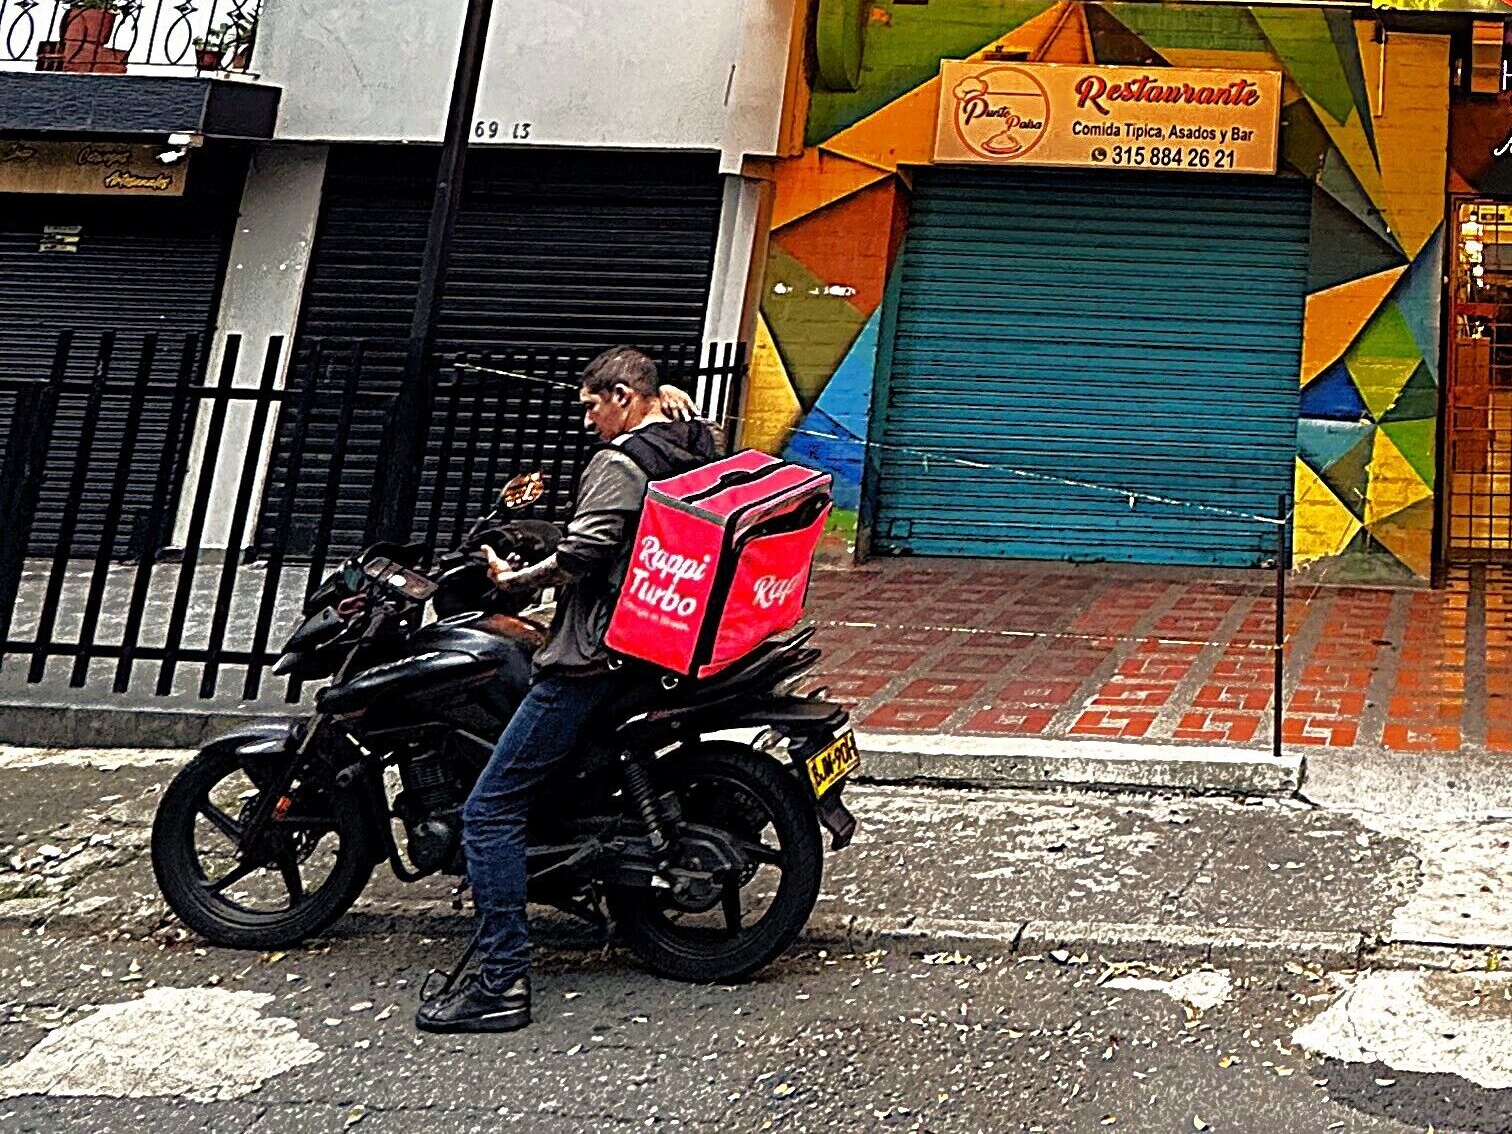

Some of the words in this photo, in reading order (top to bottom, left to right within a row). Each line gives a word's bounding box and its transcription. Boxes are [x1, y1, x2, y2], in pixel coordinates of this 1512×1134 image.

[1075, 75, 1261, 116] Restaurante
[963, 97, 1011, 126] Punto
[1005, 115, 1042, 131] Paisa
[474, 120, 499, 139] 69
[1072, 120, 1121, 137] Comida
[1168, 124, 1216, 141] Asados
[1219, 129, 1228, 144] y
[1231, 126, 1254, 142] Bar
[1111, 145, 1145, 166] 315
[1149, 147, 1183, 167] 884
[1187, 148, 1210, 168] 26
[1214, 149, 1235, 169] 21
[639, 535, 711, 584] Rappi
[630, 567, 698, 616] Turbo
[752, 574, 796, 609] Rap
